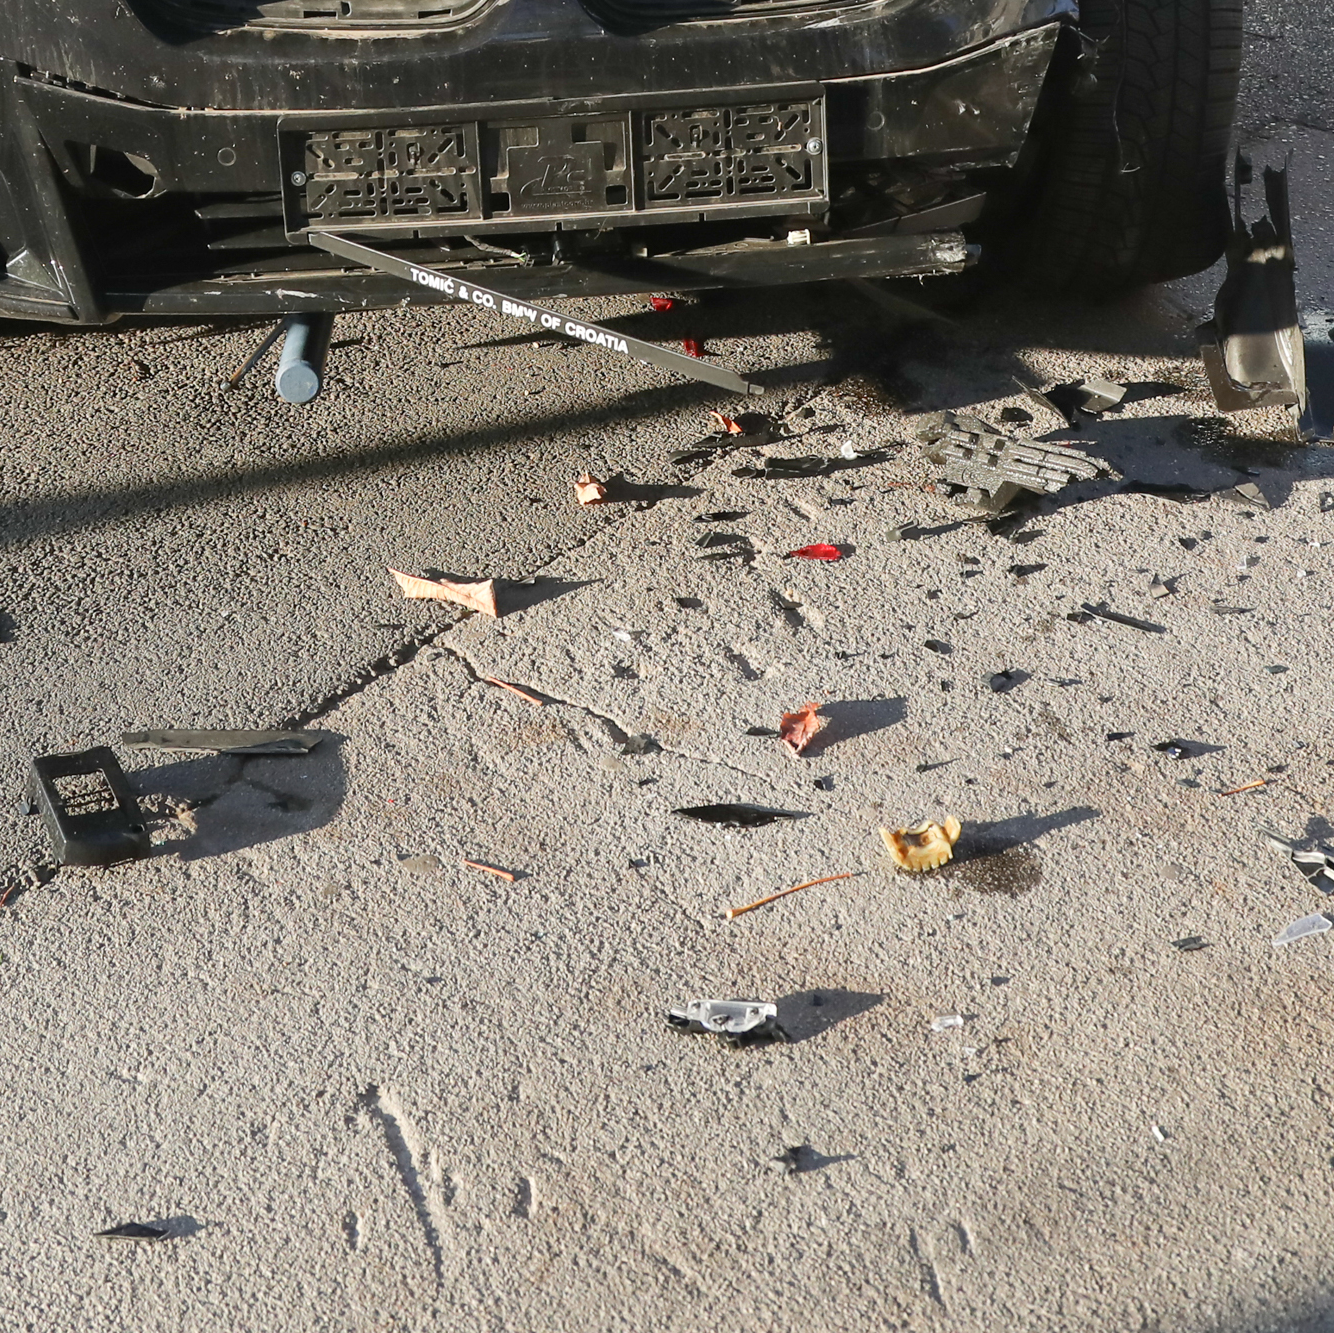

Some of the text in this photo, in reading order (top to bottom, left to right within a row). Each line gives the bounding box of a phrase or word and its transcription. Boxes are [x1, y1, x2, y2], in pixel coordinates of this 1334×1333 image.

[410, 267, 629, 354] TOMIĆ & CO. BMW OF CROATIA
